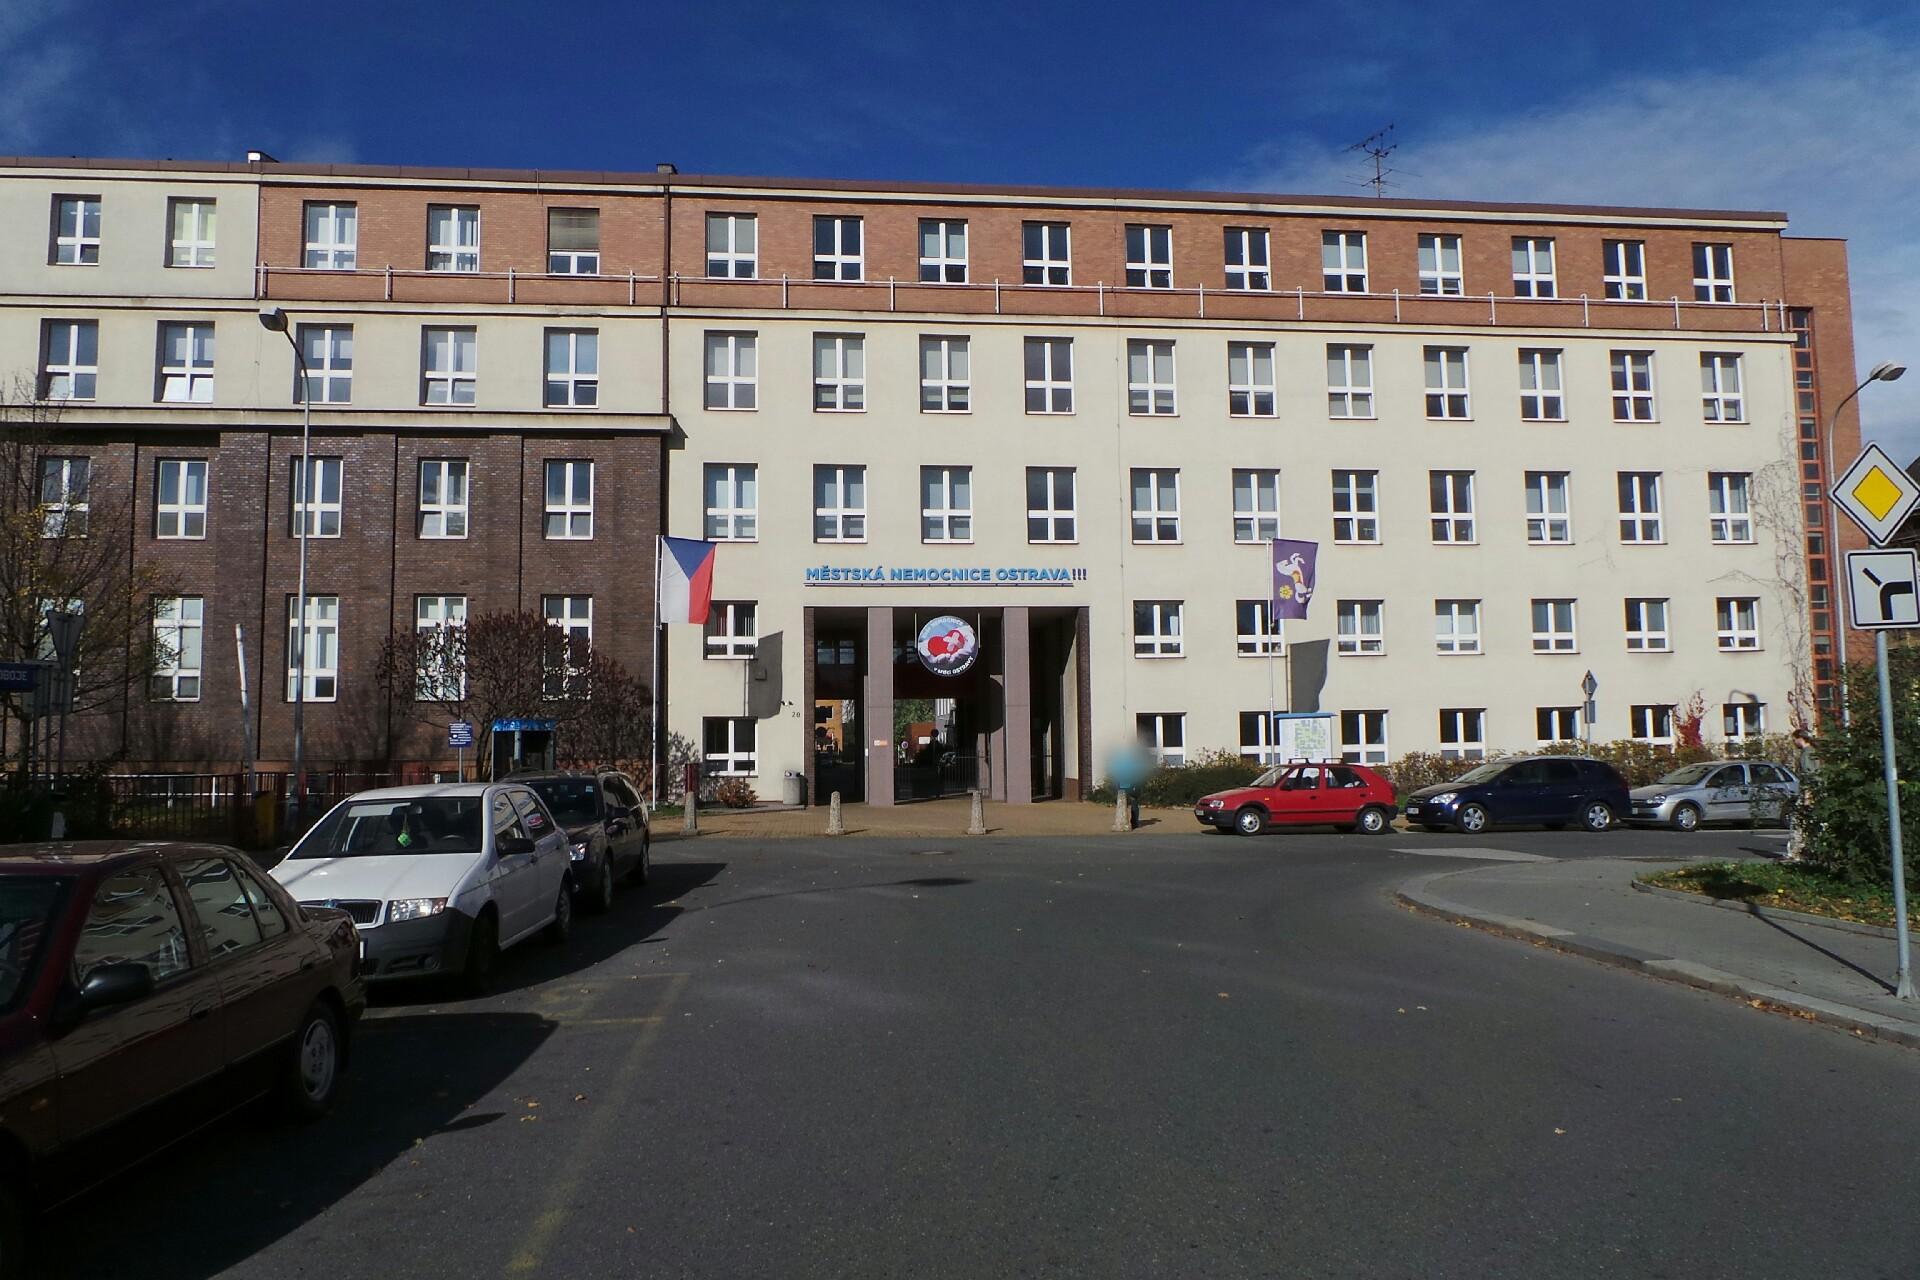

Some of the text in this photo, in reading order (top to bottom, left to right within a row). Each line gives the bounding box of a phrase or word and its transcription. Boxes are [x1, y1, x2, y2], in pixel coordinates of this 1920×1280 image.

[806, 565, 886, 581] MĚSTSKÁ
[890, 568, 991, 581] NEMOCNICE
[952, 655, 974, 674] OSTRAVY
